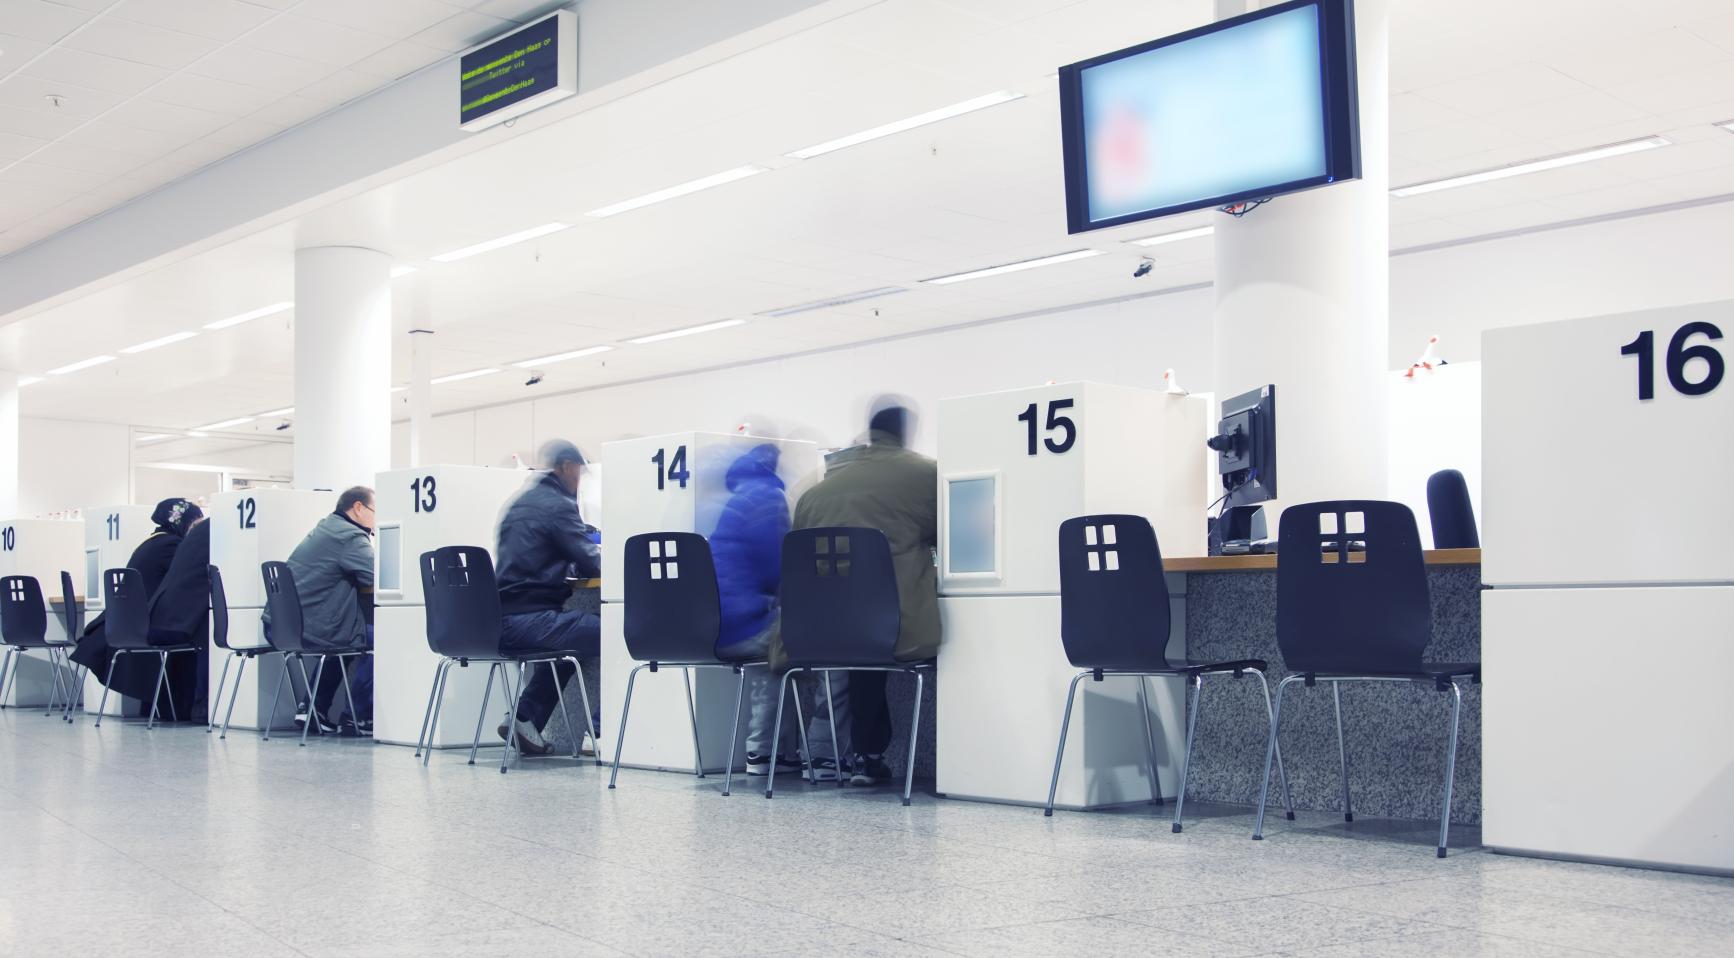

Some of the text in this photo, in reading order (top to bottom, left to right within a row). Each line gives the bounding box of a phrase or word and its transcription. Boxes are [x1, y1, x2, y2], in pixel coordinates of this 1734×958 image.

[1620, 321, 1726, 401] 16
[1017, 397, 1077, 456] 15
[651, 445, 690, 491] 14
[410, 475, 437, 513] 13
[106, 513, 120, 541] 11
[236, 497, 256, 530] 12
[1, 526, 15, 552] 10
